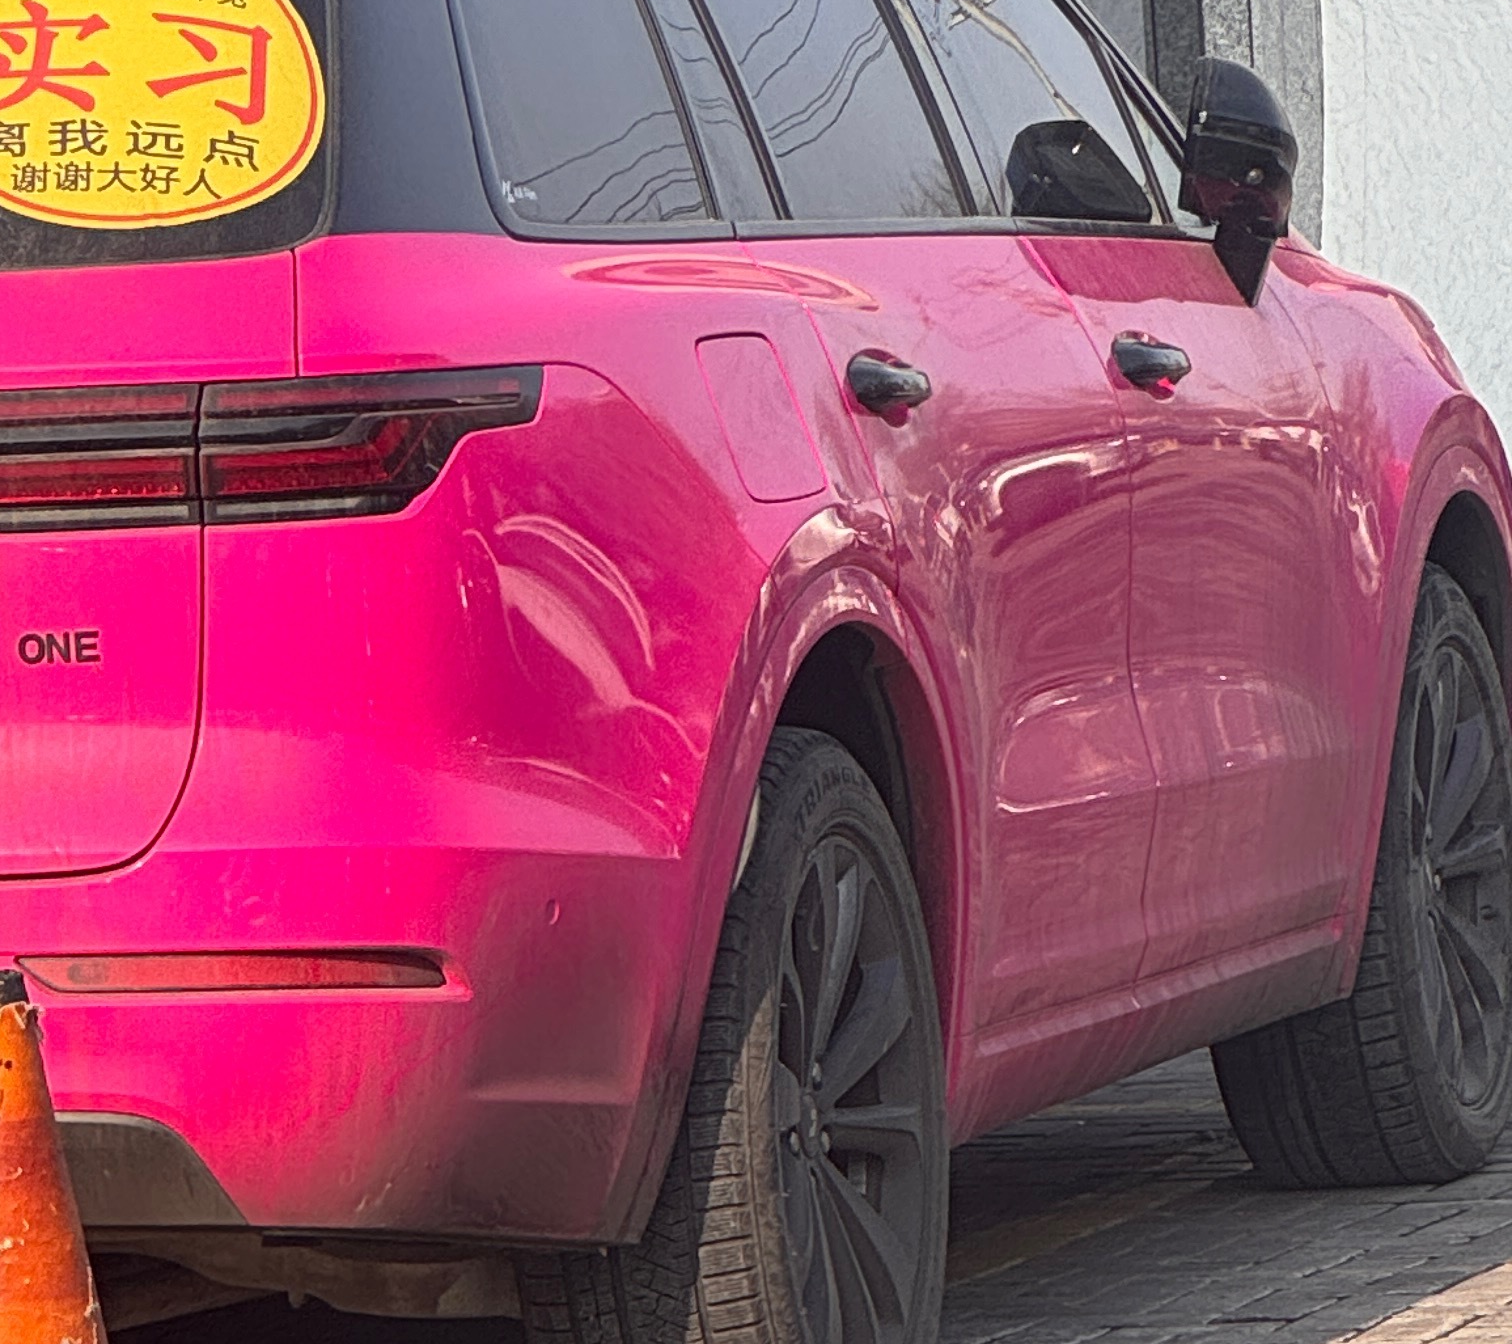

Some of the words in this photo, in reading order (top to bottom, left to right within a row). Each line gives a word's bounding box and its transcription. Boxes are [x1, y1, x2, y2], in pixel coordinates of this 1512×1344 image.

[11, 161, 223, 199] 谢谢大好人
[18, 630, 101, 665] ONE
